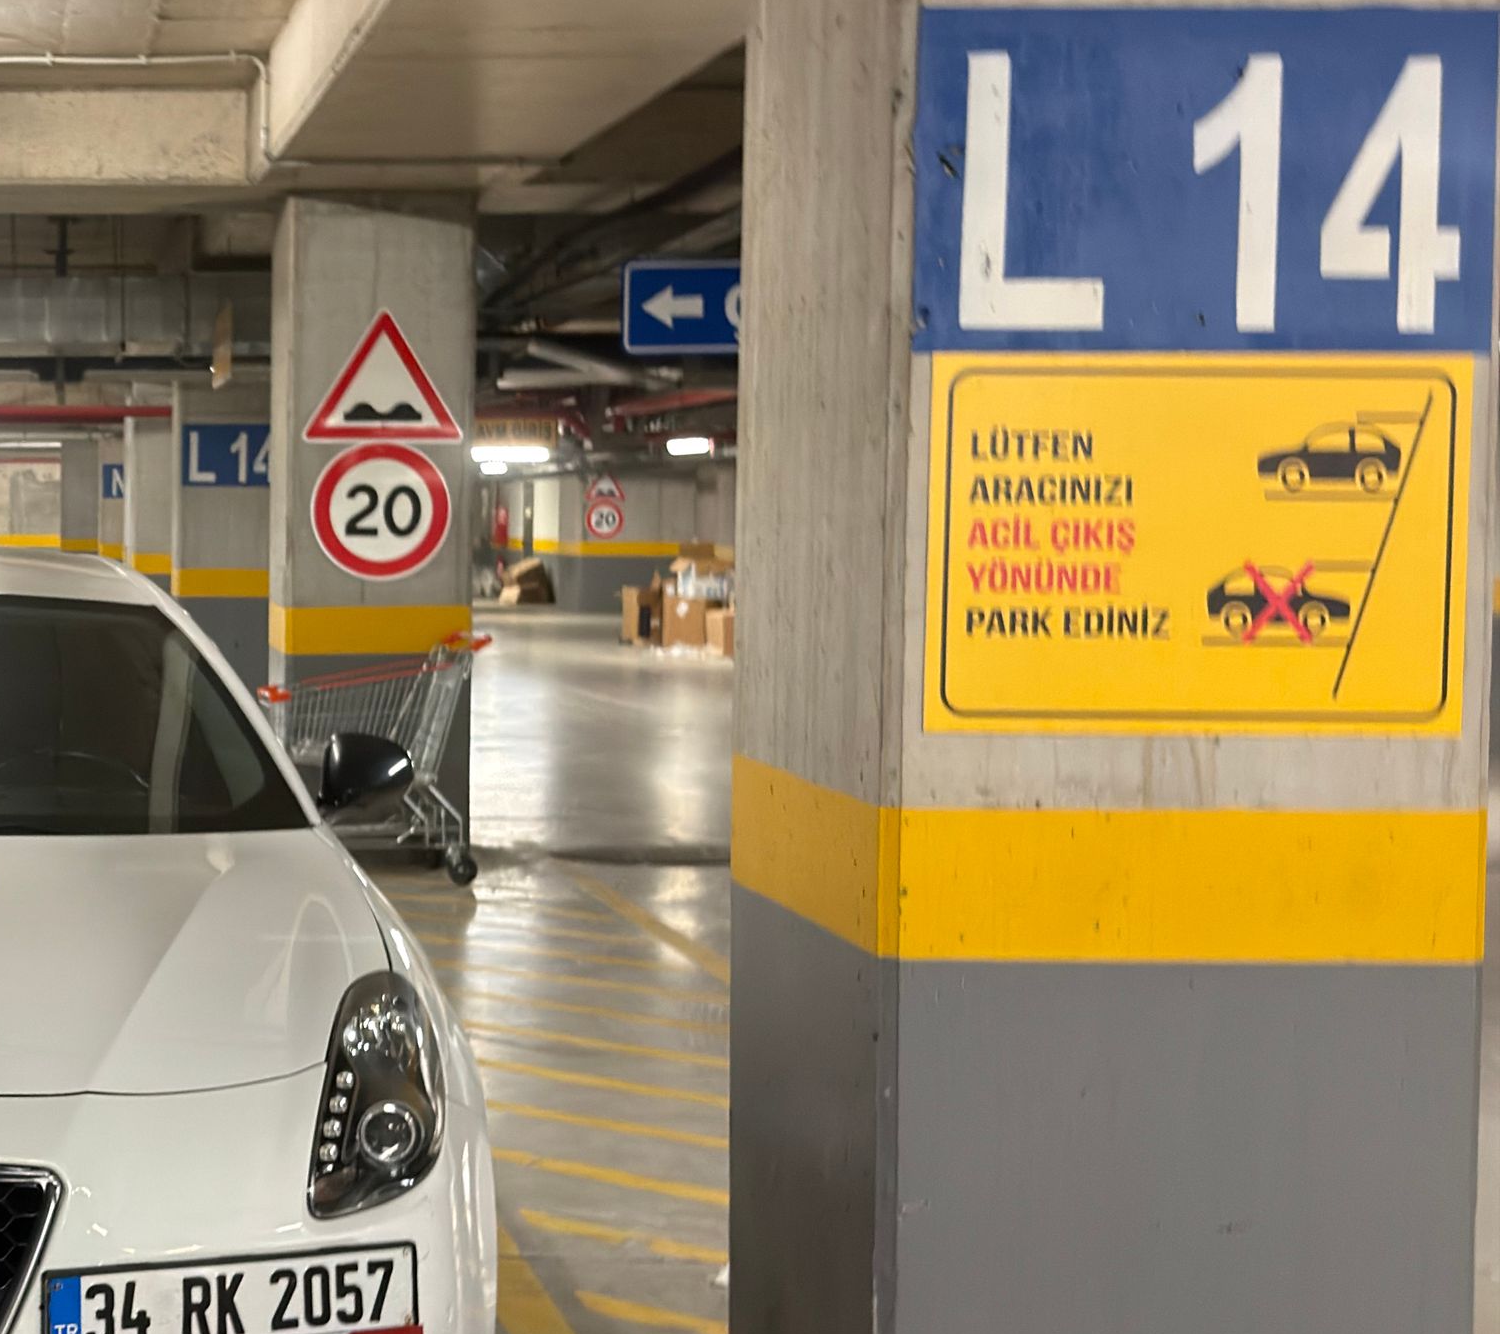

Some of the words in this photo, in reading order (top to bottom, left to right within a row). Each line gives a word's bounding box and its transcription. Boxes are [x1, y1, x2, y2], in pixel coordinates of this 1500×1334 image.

[959, 51, 1104, 330] L
[1194, 52, 1461, 334] 14
[189, 431, 217, 483] L
[230, 432, 270, 484] 14
[970, 425, 1093, 461] LÜTFEN
[345, 484, 422, 537] 20
[969, 475, 1134, 506] ARACINIZI
[967, 514, 1040, 550] ACİL
[1050, 517, 1136, 557] ÇIKIŞ
[966, 557, 1122, 594] YÖNÜNDE
[965, 606, 1052, 639] PARK
[1063, 601, 1171, 640] EDİNİZ
[270, 1260, 394, 1330] 2057
